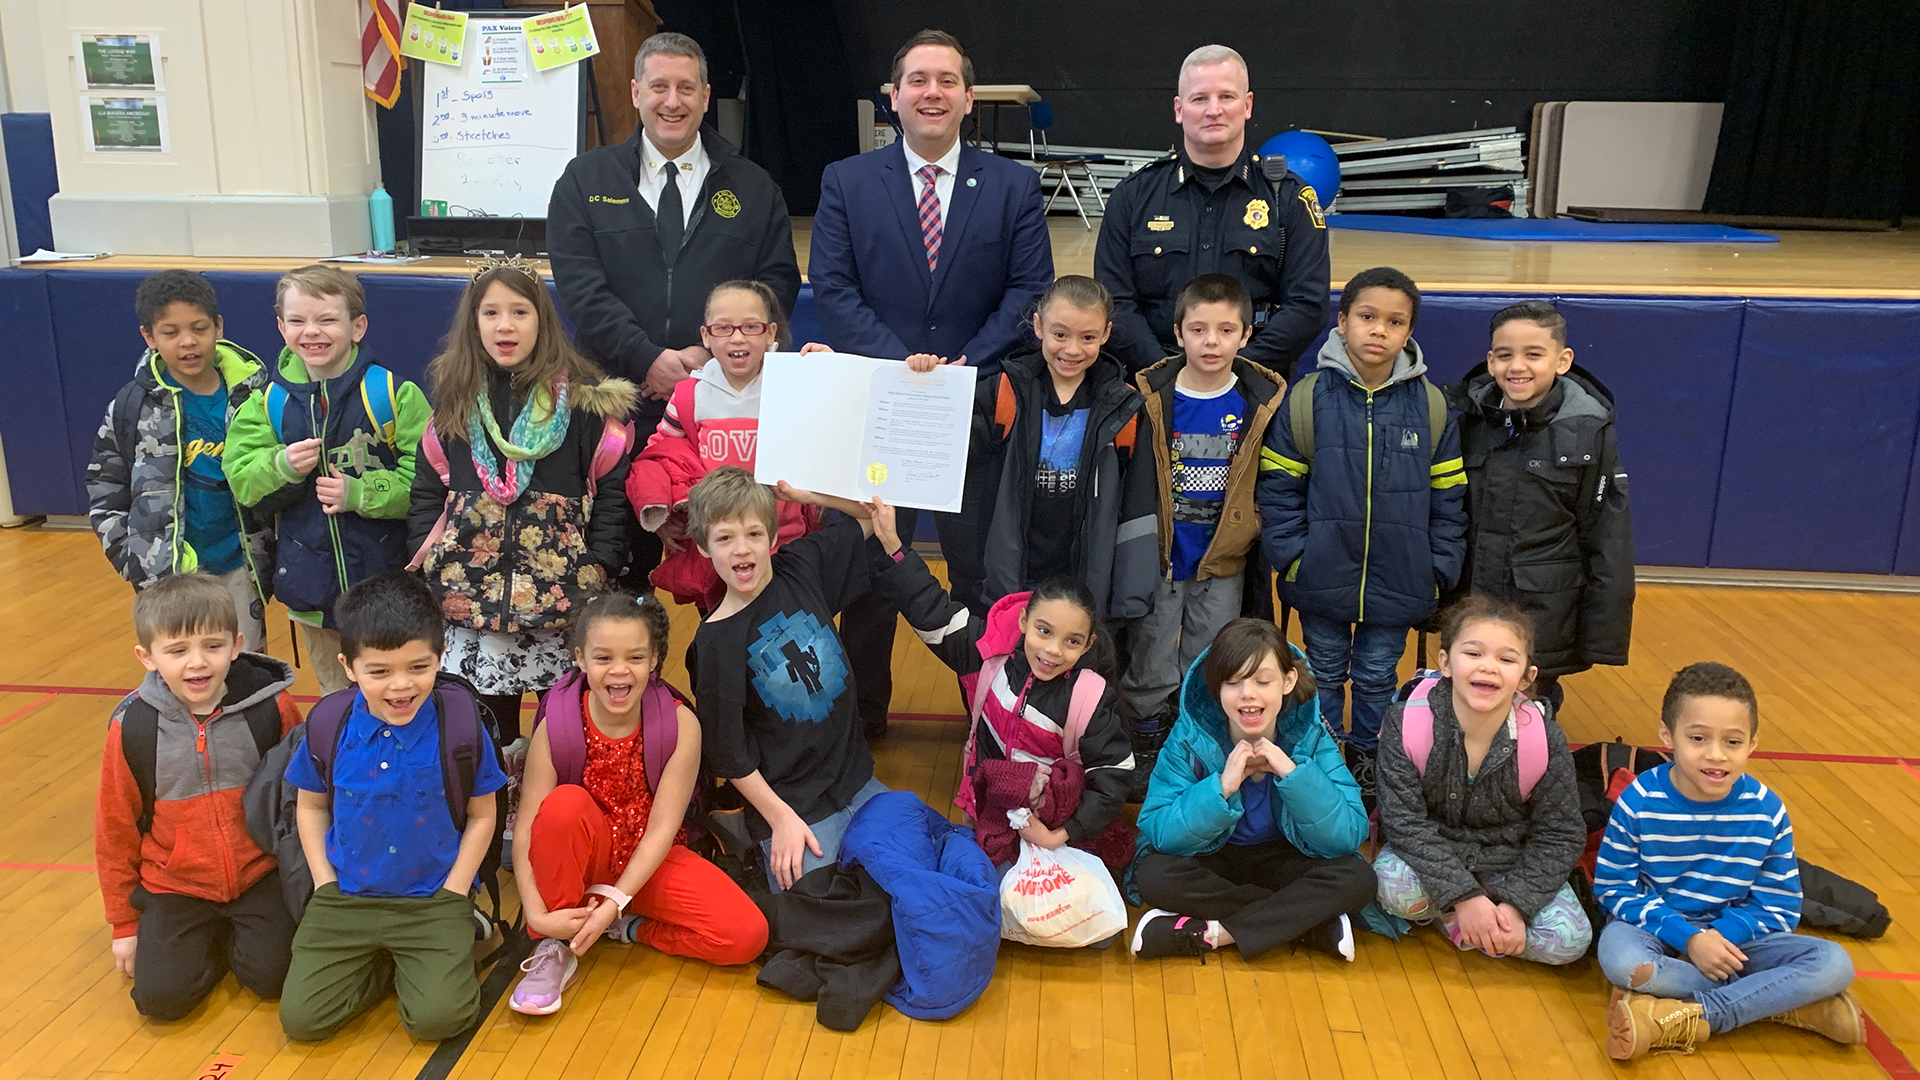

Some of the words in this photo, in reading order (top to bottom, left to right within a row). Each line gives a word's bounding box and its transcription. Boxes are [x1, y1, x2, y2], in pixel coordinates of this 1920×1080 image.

[470, 107, 506, 120] minute
[506, 109, 533, 117] move
[456, 128, 511, 141] Stretches
[1529, 460, 1541, 468] CK
